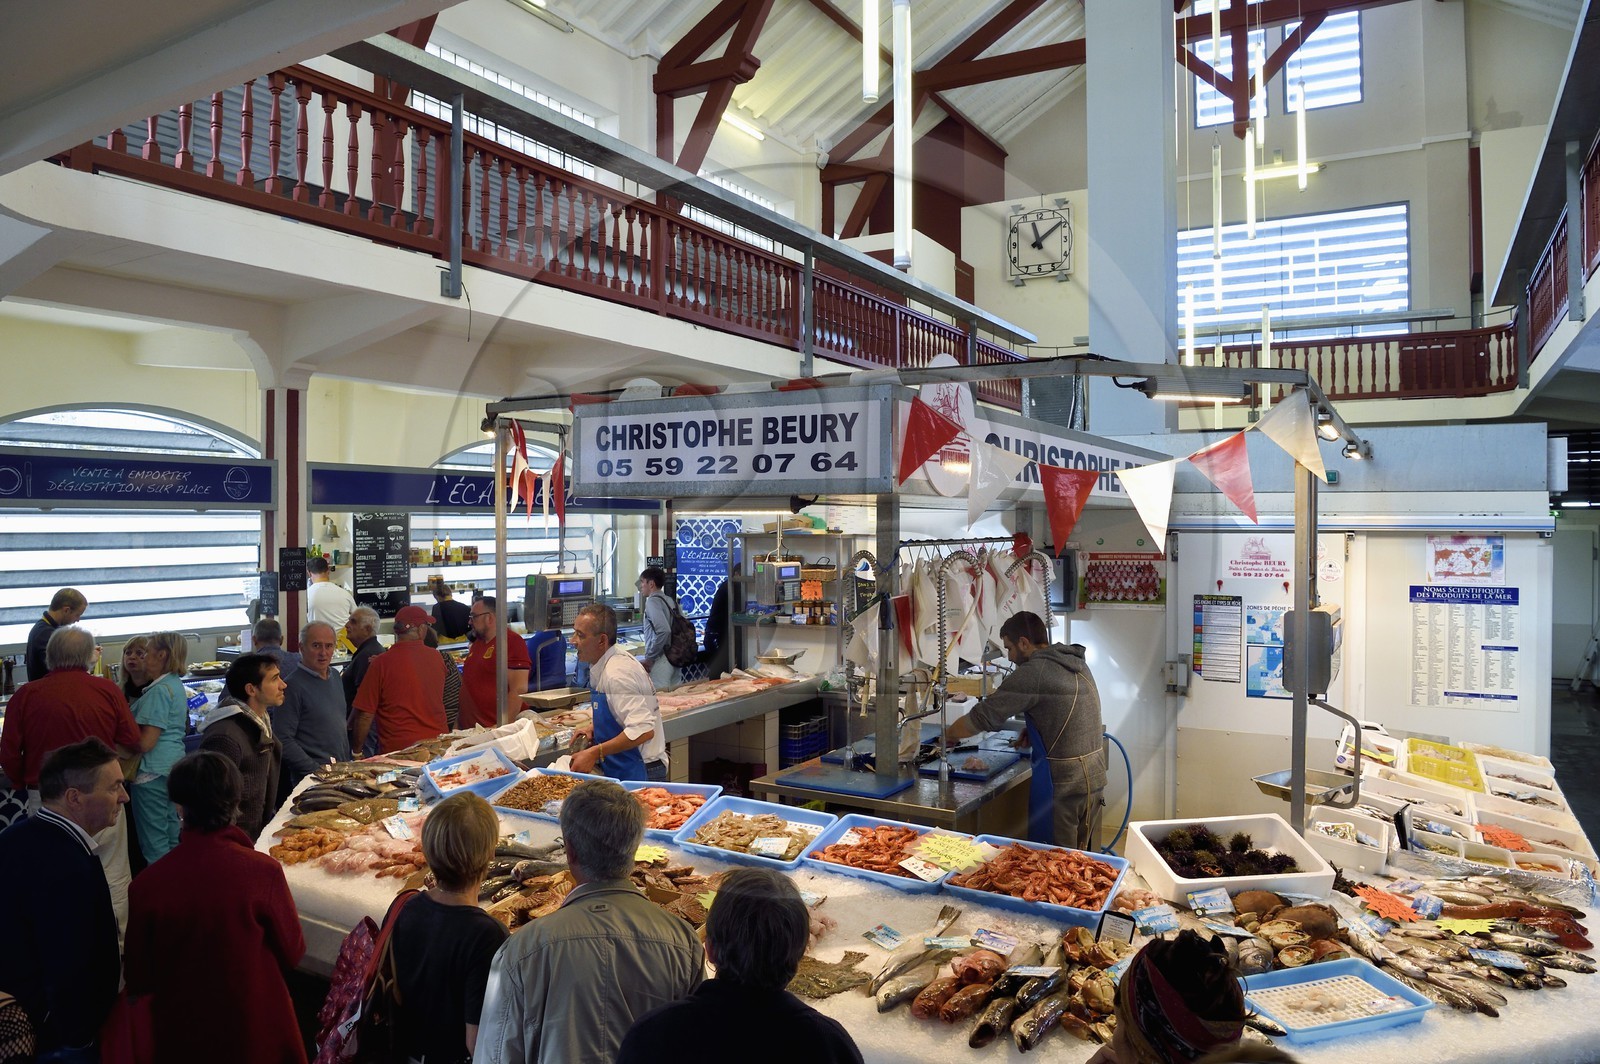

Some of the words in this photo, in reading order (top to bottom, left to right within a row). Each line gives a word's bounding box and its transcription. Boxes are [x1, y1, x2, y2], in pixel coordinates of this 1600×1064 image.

[596, 418, 752, 451] CHRISTOPHE
[762, 412, 859, 445] BEURY
[596, 458, 632, 477] 05
[646, 457, 684, 476] 59
[696, 455, 738, 474] 22
[752, 454, 796, 473] 07
[810, 451, 858, 472] 64
[72, 466, 112, 478] VENTE
[128, 470, 191, 481] EMPORTER
[47, 478, 141, 493] DÉGUSTATION
[146, 483, 170, 494] SUR
[176, 484, 212, 495] PLACE
[681, 550, 728, 560] L'ÉCAILLERI
